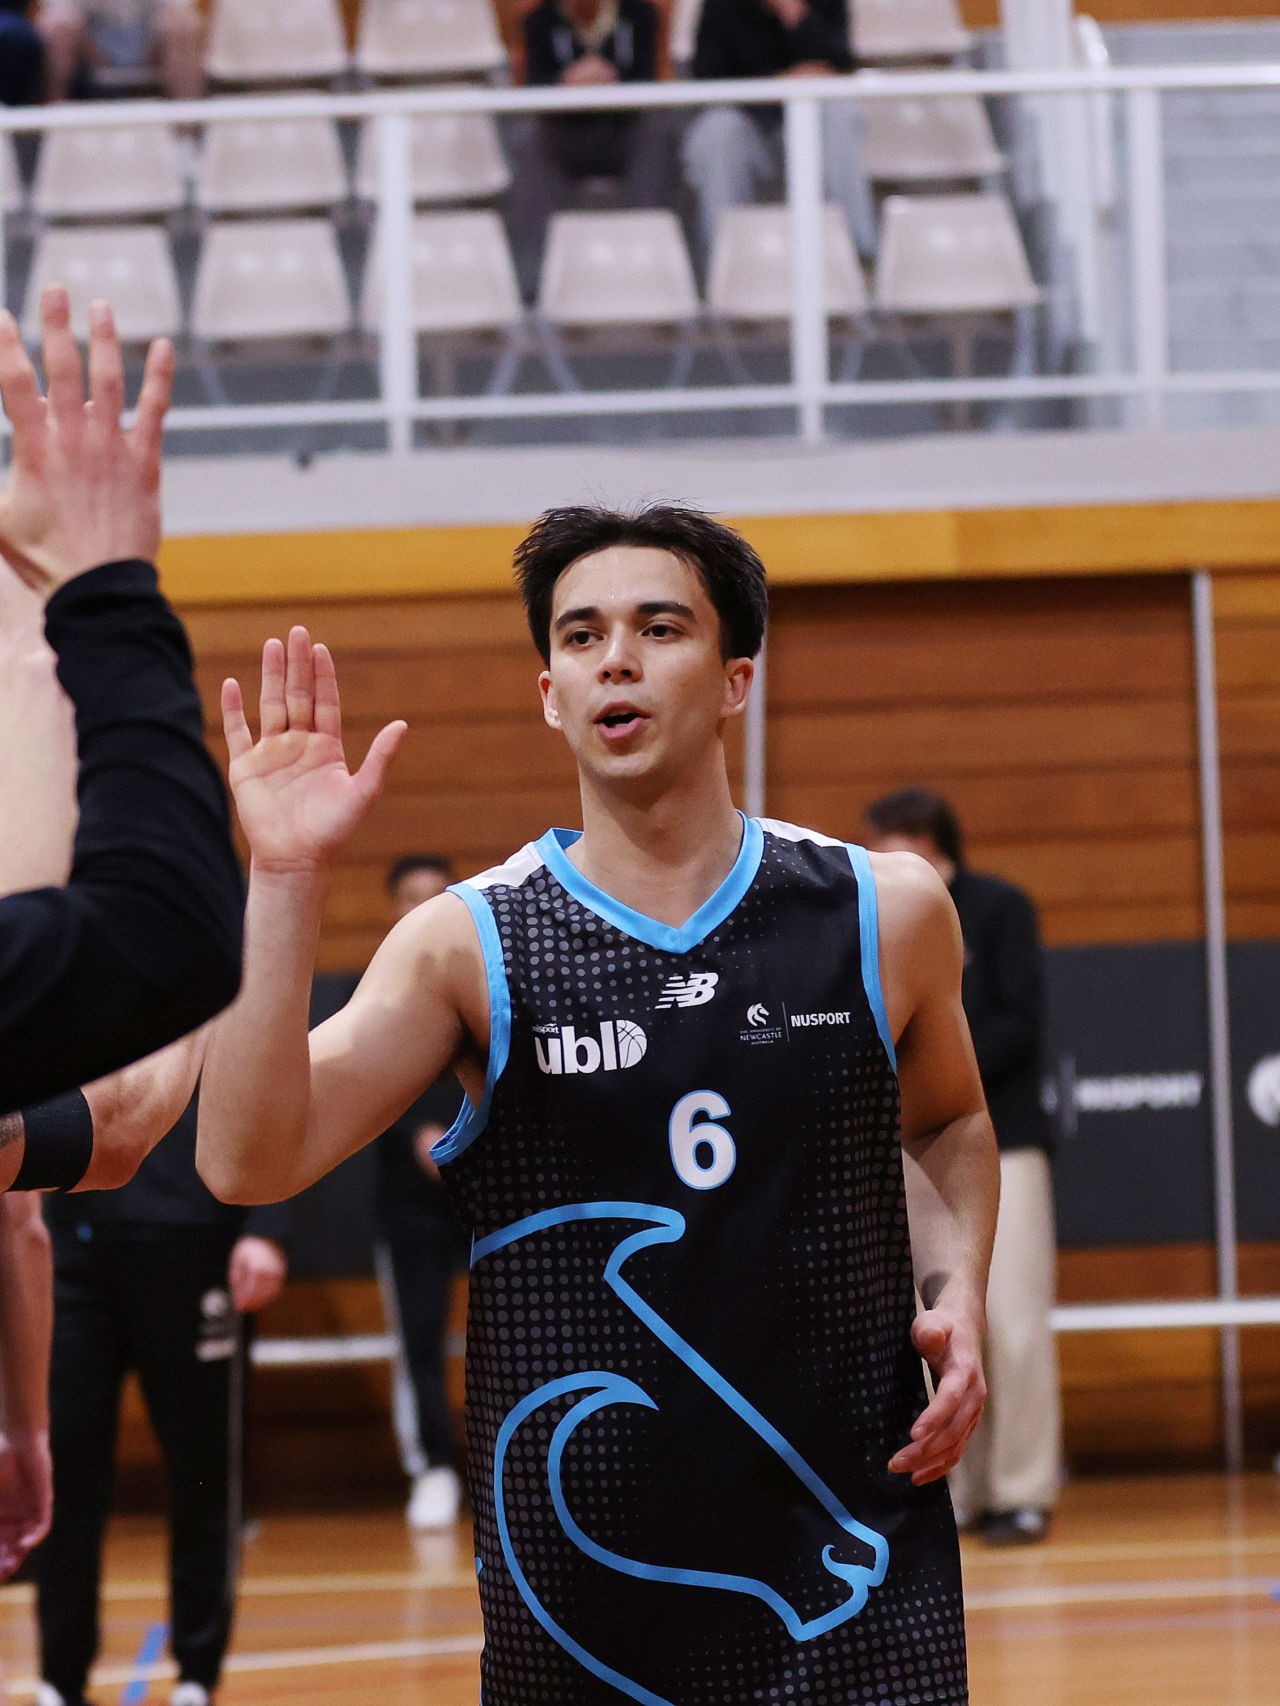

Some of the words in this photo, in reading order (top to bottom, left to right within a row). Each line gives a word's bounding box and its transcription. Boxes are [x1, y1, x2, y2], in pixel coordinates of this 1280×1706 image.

[790, 1011, 851, 1028] NUSPORT
[739, 1031, 782, 1041] NEWCASTLE
[669, 1089, 737, 1191] 6
